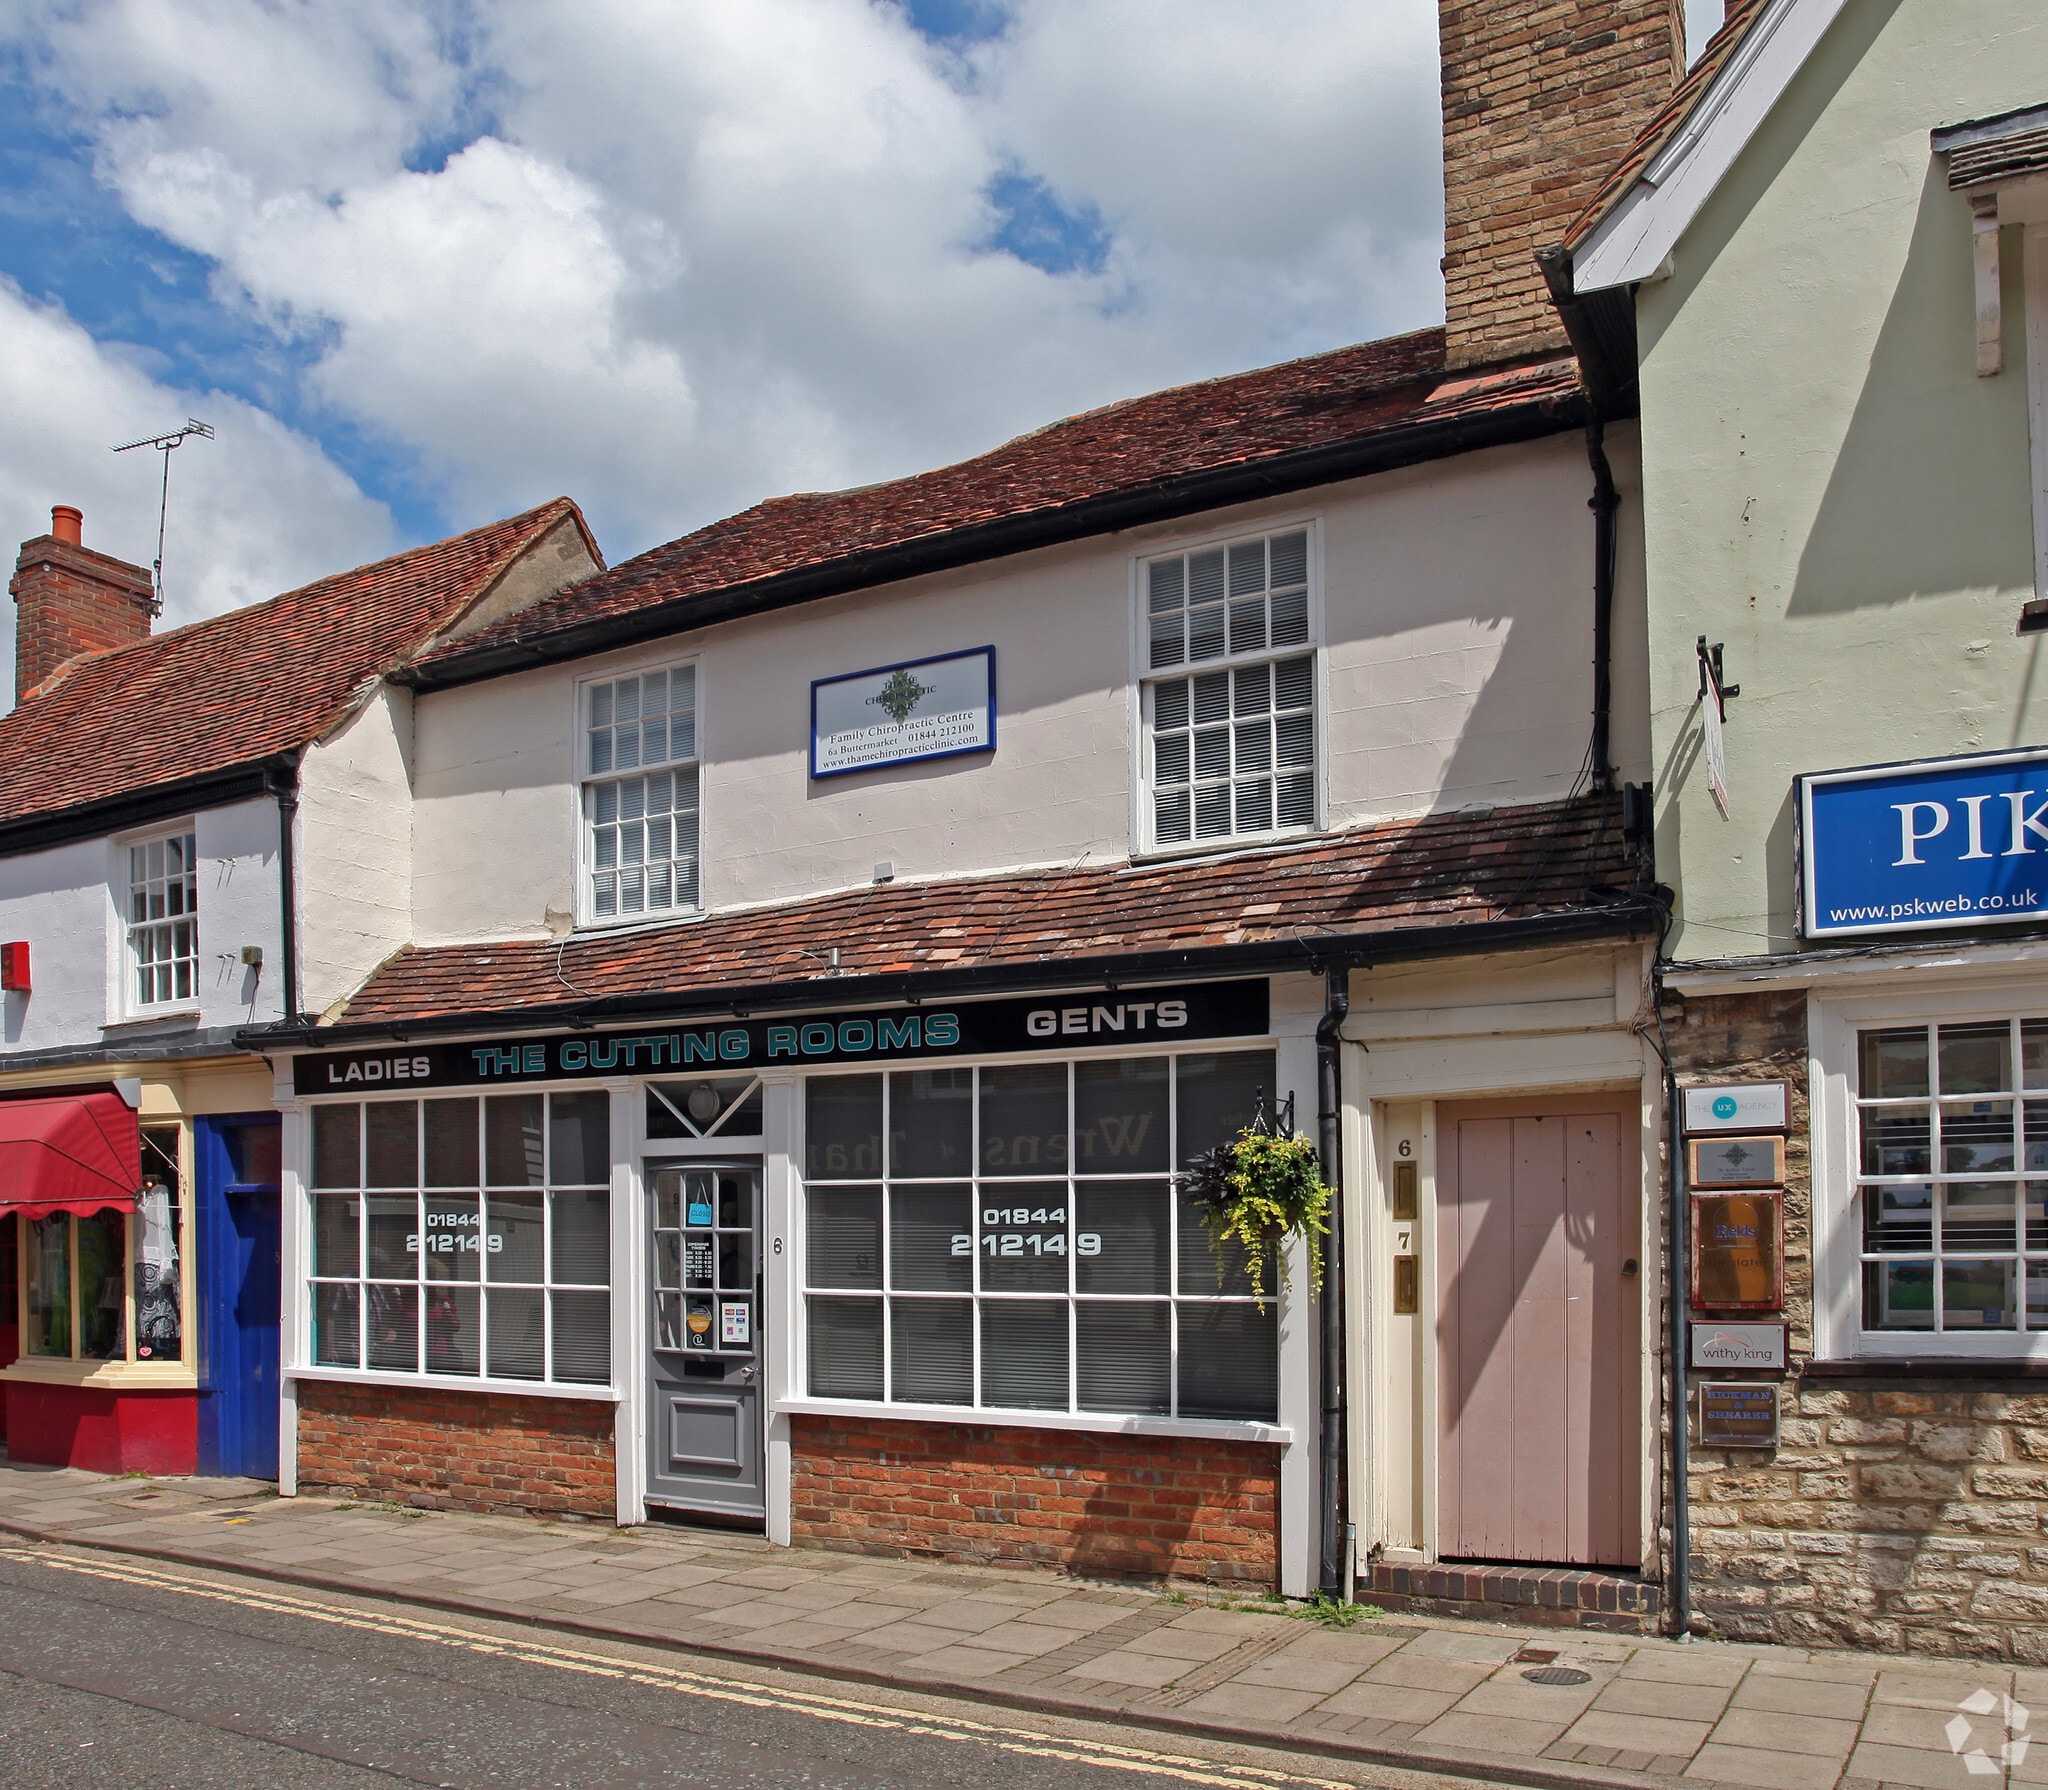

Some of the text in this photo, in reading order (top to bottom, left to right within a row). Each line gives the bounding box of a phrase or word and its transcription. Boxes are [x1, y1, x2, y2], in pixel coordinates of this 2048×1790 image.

[830, 711, 974, 745] Family Chiropractic Centre
[828, 723, 975, 757] 6a Buttermarket 01844 212100
[823, 734, 979, 769] www.thamechiropracticclinic.com
[1830, 888, 2038, 922] www.pskweb.co.uk
[1027, 1000, 1189, 1037] GENTS
[472, 1013, 960, 1077] THE CUTTING ROOMS
[328, 1056, 431, 1084] LADIES
[1717, 1103, 1733, 1112] UX
[1738, 1101, 1778, 1111] AGENCY
[1398, 1139, 1412, 1157] 6
[427, 1213, 479, 1227] 01844
[983, 1208, 1066, 1225] 01844
[406, 1234, 503, 1253] 212149
[773, 1238, 782, 1255] 6
[950, 1233, 1102, 1256] 212149
[1397, 1232, 1410, 1250] 7
[1703, 1348, 1773, 1361] withy king
[1707, 1391, 1770, 1400] HICKMAN
[1708, 1411, 1770, 1420] SHEARER
